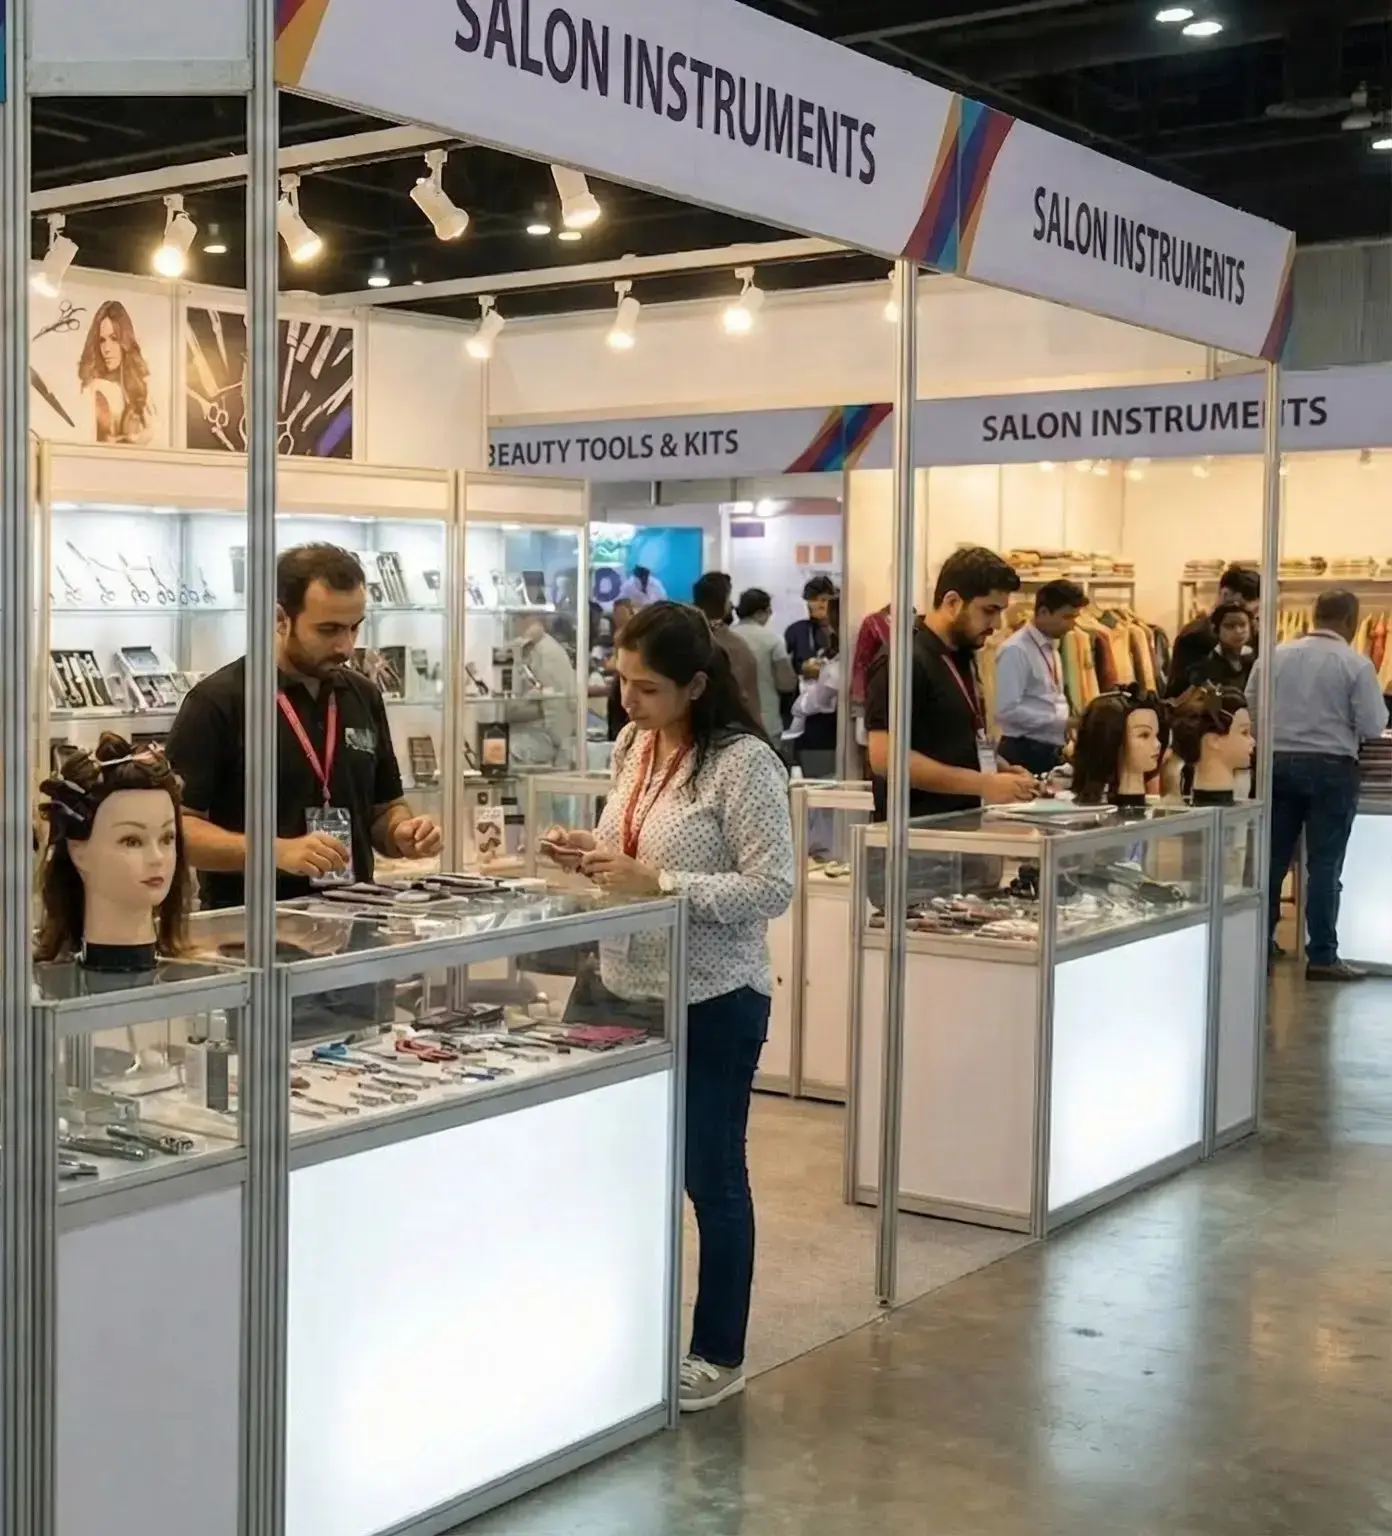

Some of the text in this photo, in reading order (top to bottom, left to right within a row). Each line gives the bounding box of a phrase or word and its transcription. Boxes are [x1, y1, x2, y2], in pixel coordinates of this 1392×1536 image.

[454, 0, 876, 185] SALON INSTRUMENTS
[1033, 186, 1245, 306] SALON INSTRUMENTS
[575, 433, 654, 462] TOOLS
[660, 432, 678, 458] &
[684, 429, 739, 456] KITS
[983, 396, 1328, 442] SALON INSTRUMETS
